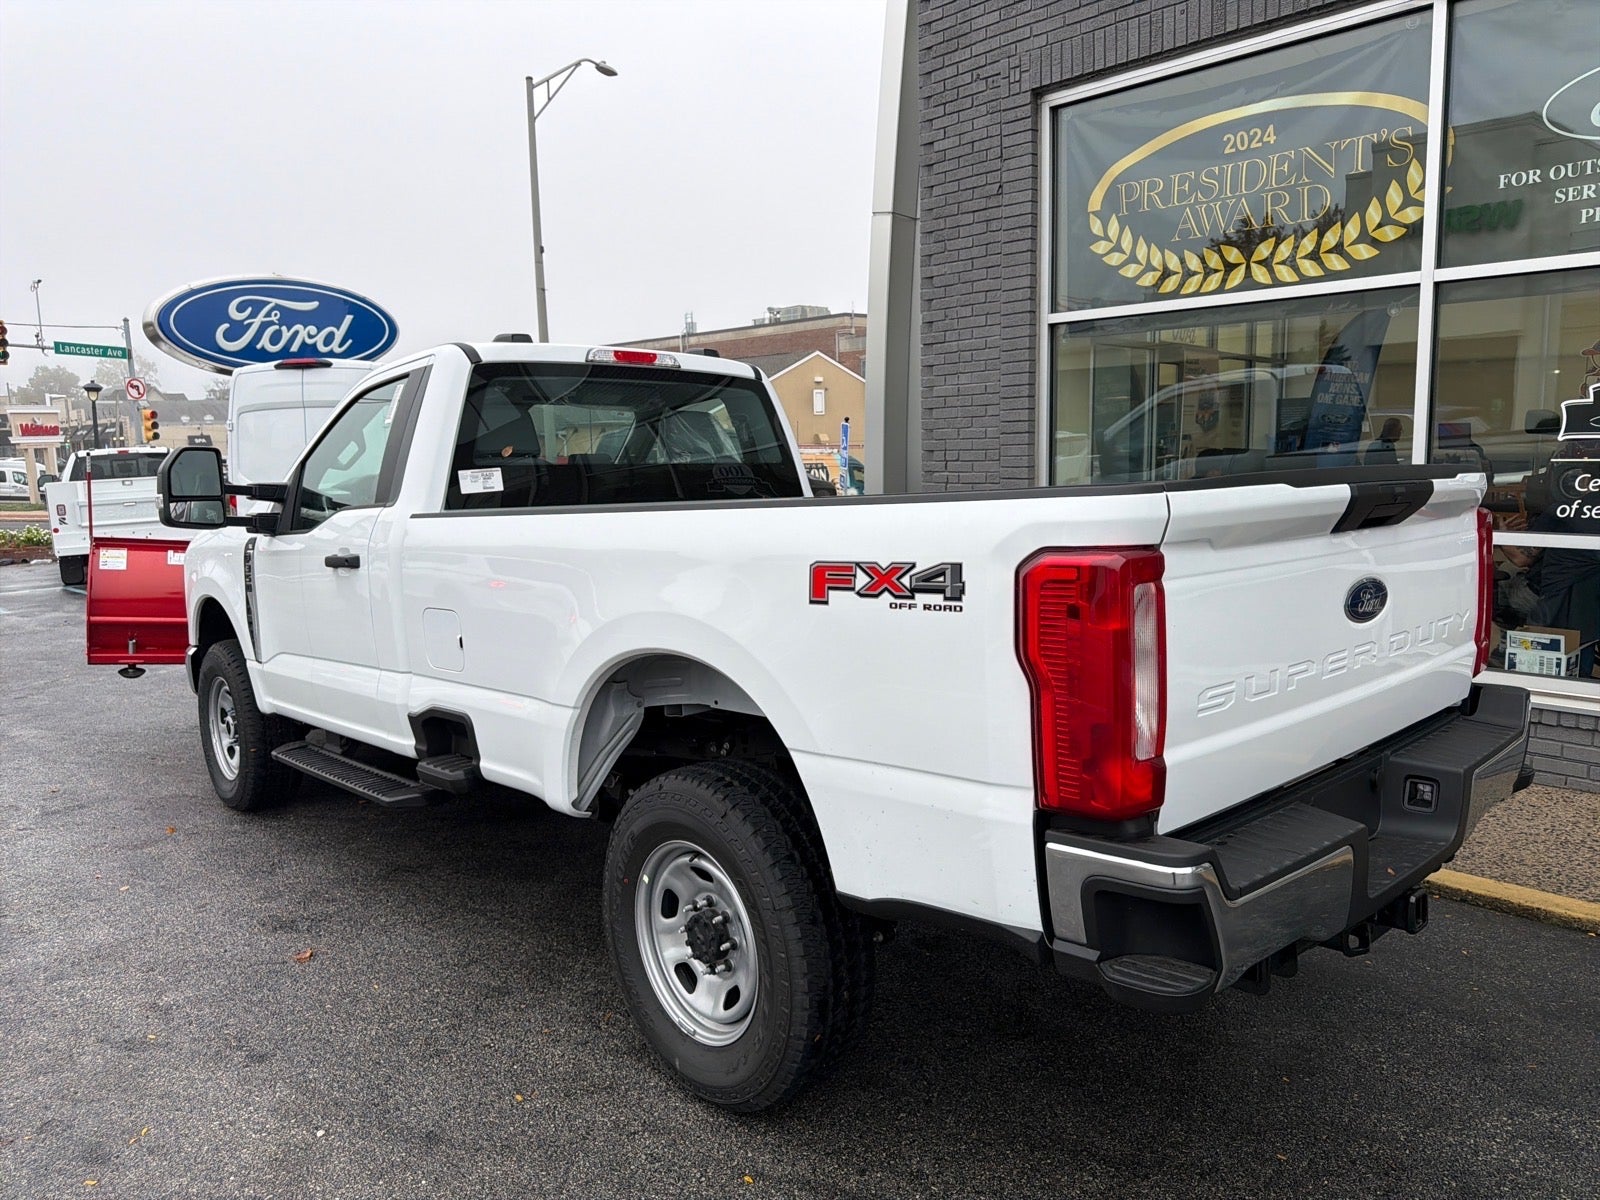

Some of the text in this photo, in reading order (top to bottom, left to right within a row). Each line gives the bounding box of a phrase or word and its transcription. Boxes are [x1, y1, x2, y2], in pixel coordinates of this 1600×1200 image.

[1223, 124, 1276, 154] 2024
[1116, 126, 1413, 216] PRESIDENT'S
[1498, 169, 1542, 189] FOR
[1555, 183, 1600, 204] SER
[1171, 184, 1331, 242] AWARD
[215, 295, 354, 354] Ford
[60, 344, 122, 357] Lancaster Ave
[1574, 473, 1600, 492] Ce
[1556, 499, 1600, 519] of se
[809, 560, 966, 606] FX4
[889, 602, 964, 613] OFF ROAD
[1197, 640, 1378, 718] SUPER
[1389, 608, 1471, 657] DUTY
